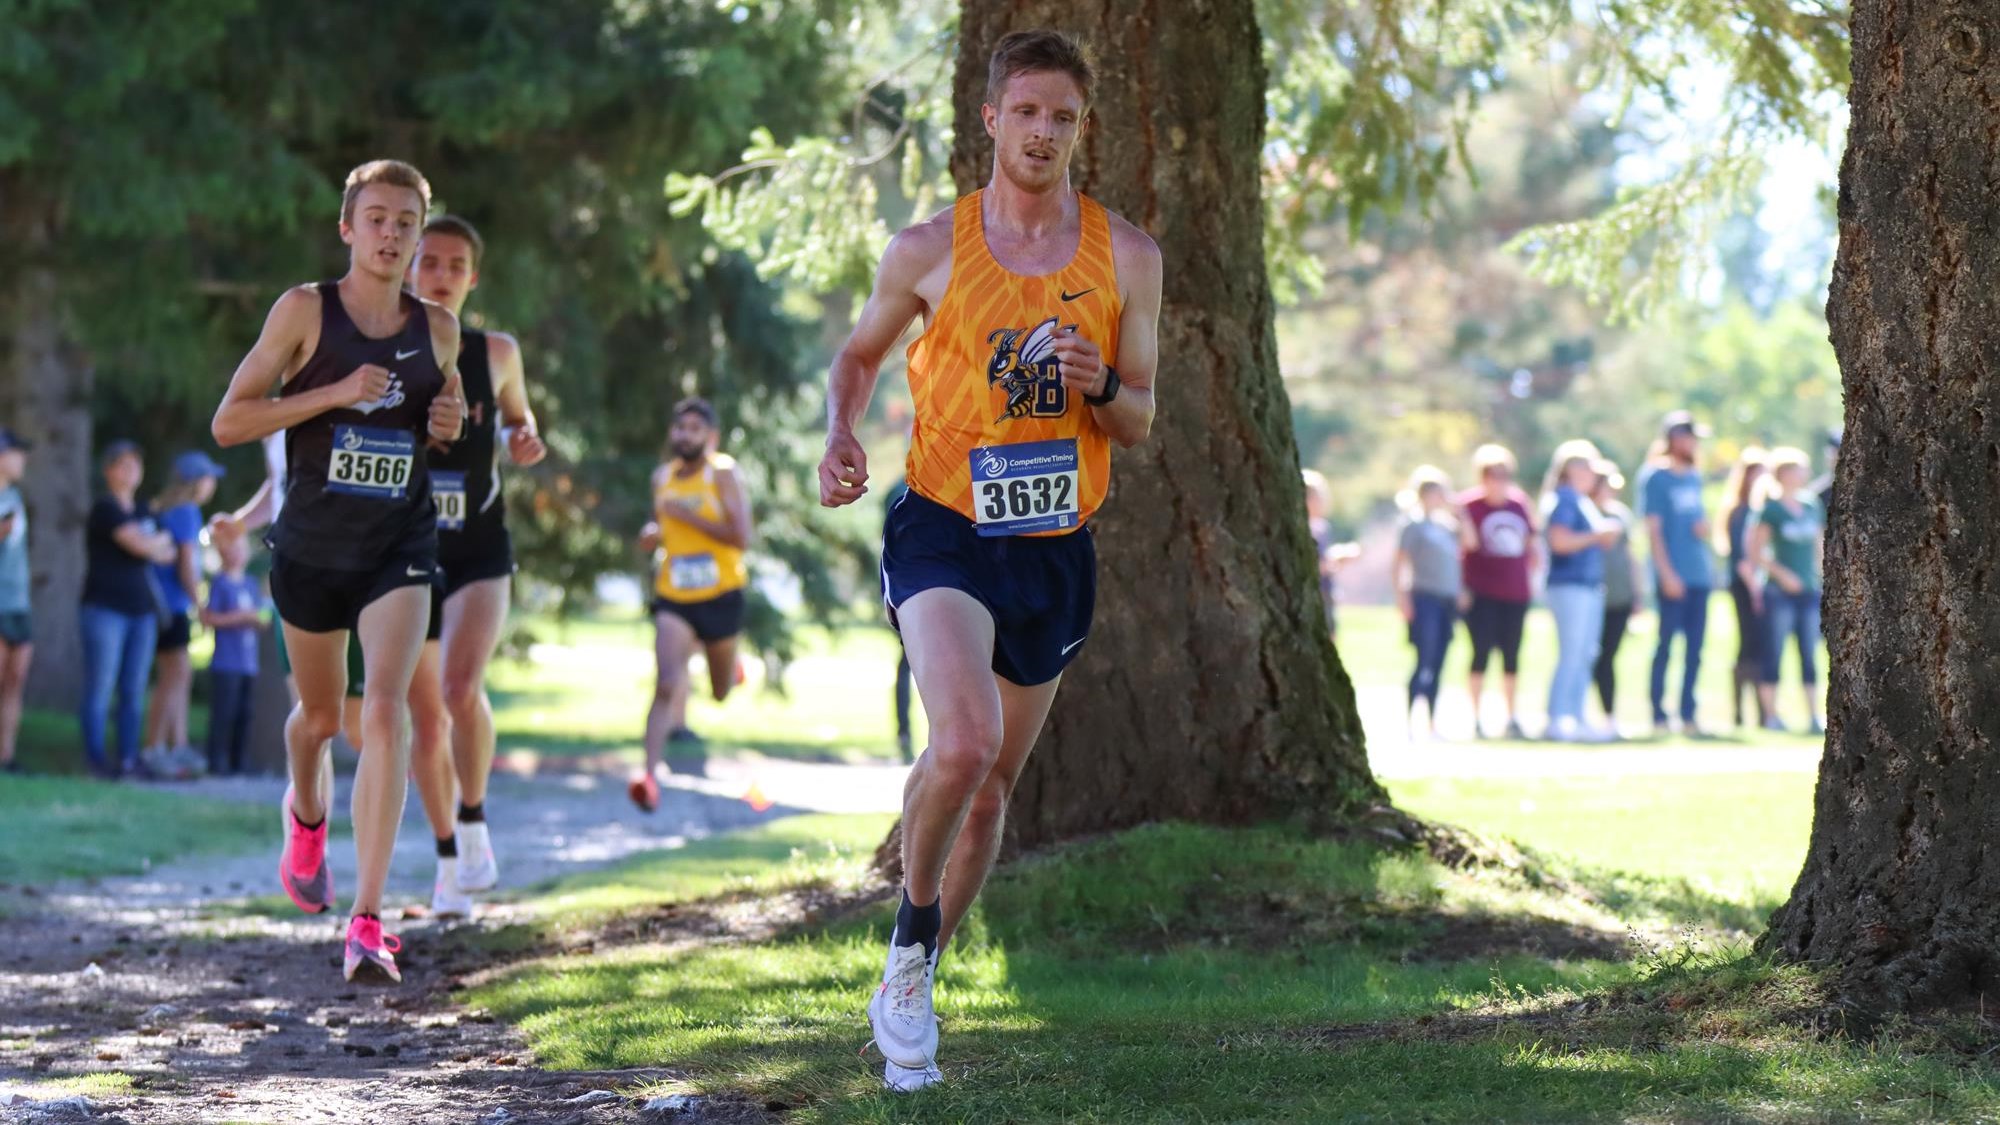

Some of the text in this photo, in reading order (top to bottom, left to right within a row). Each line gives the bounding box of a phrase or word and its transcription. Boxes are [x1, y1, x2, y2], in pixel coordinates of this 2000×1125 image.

[1030, 355, 1068, 418] B
[336, 453, 407, 484] 3566
[983, 475, 1072, 520] 3632
